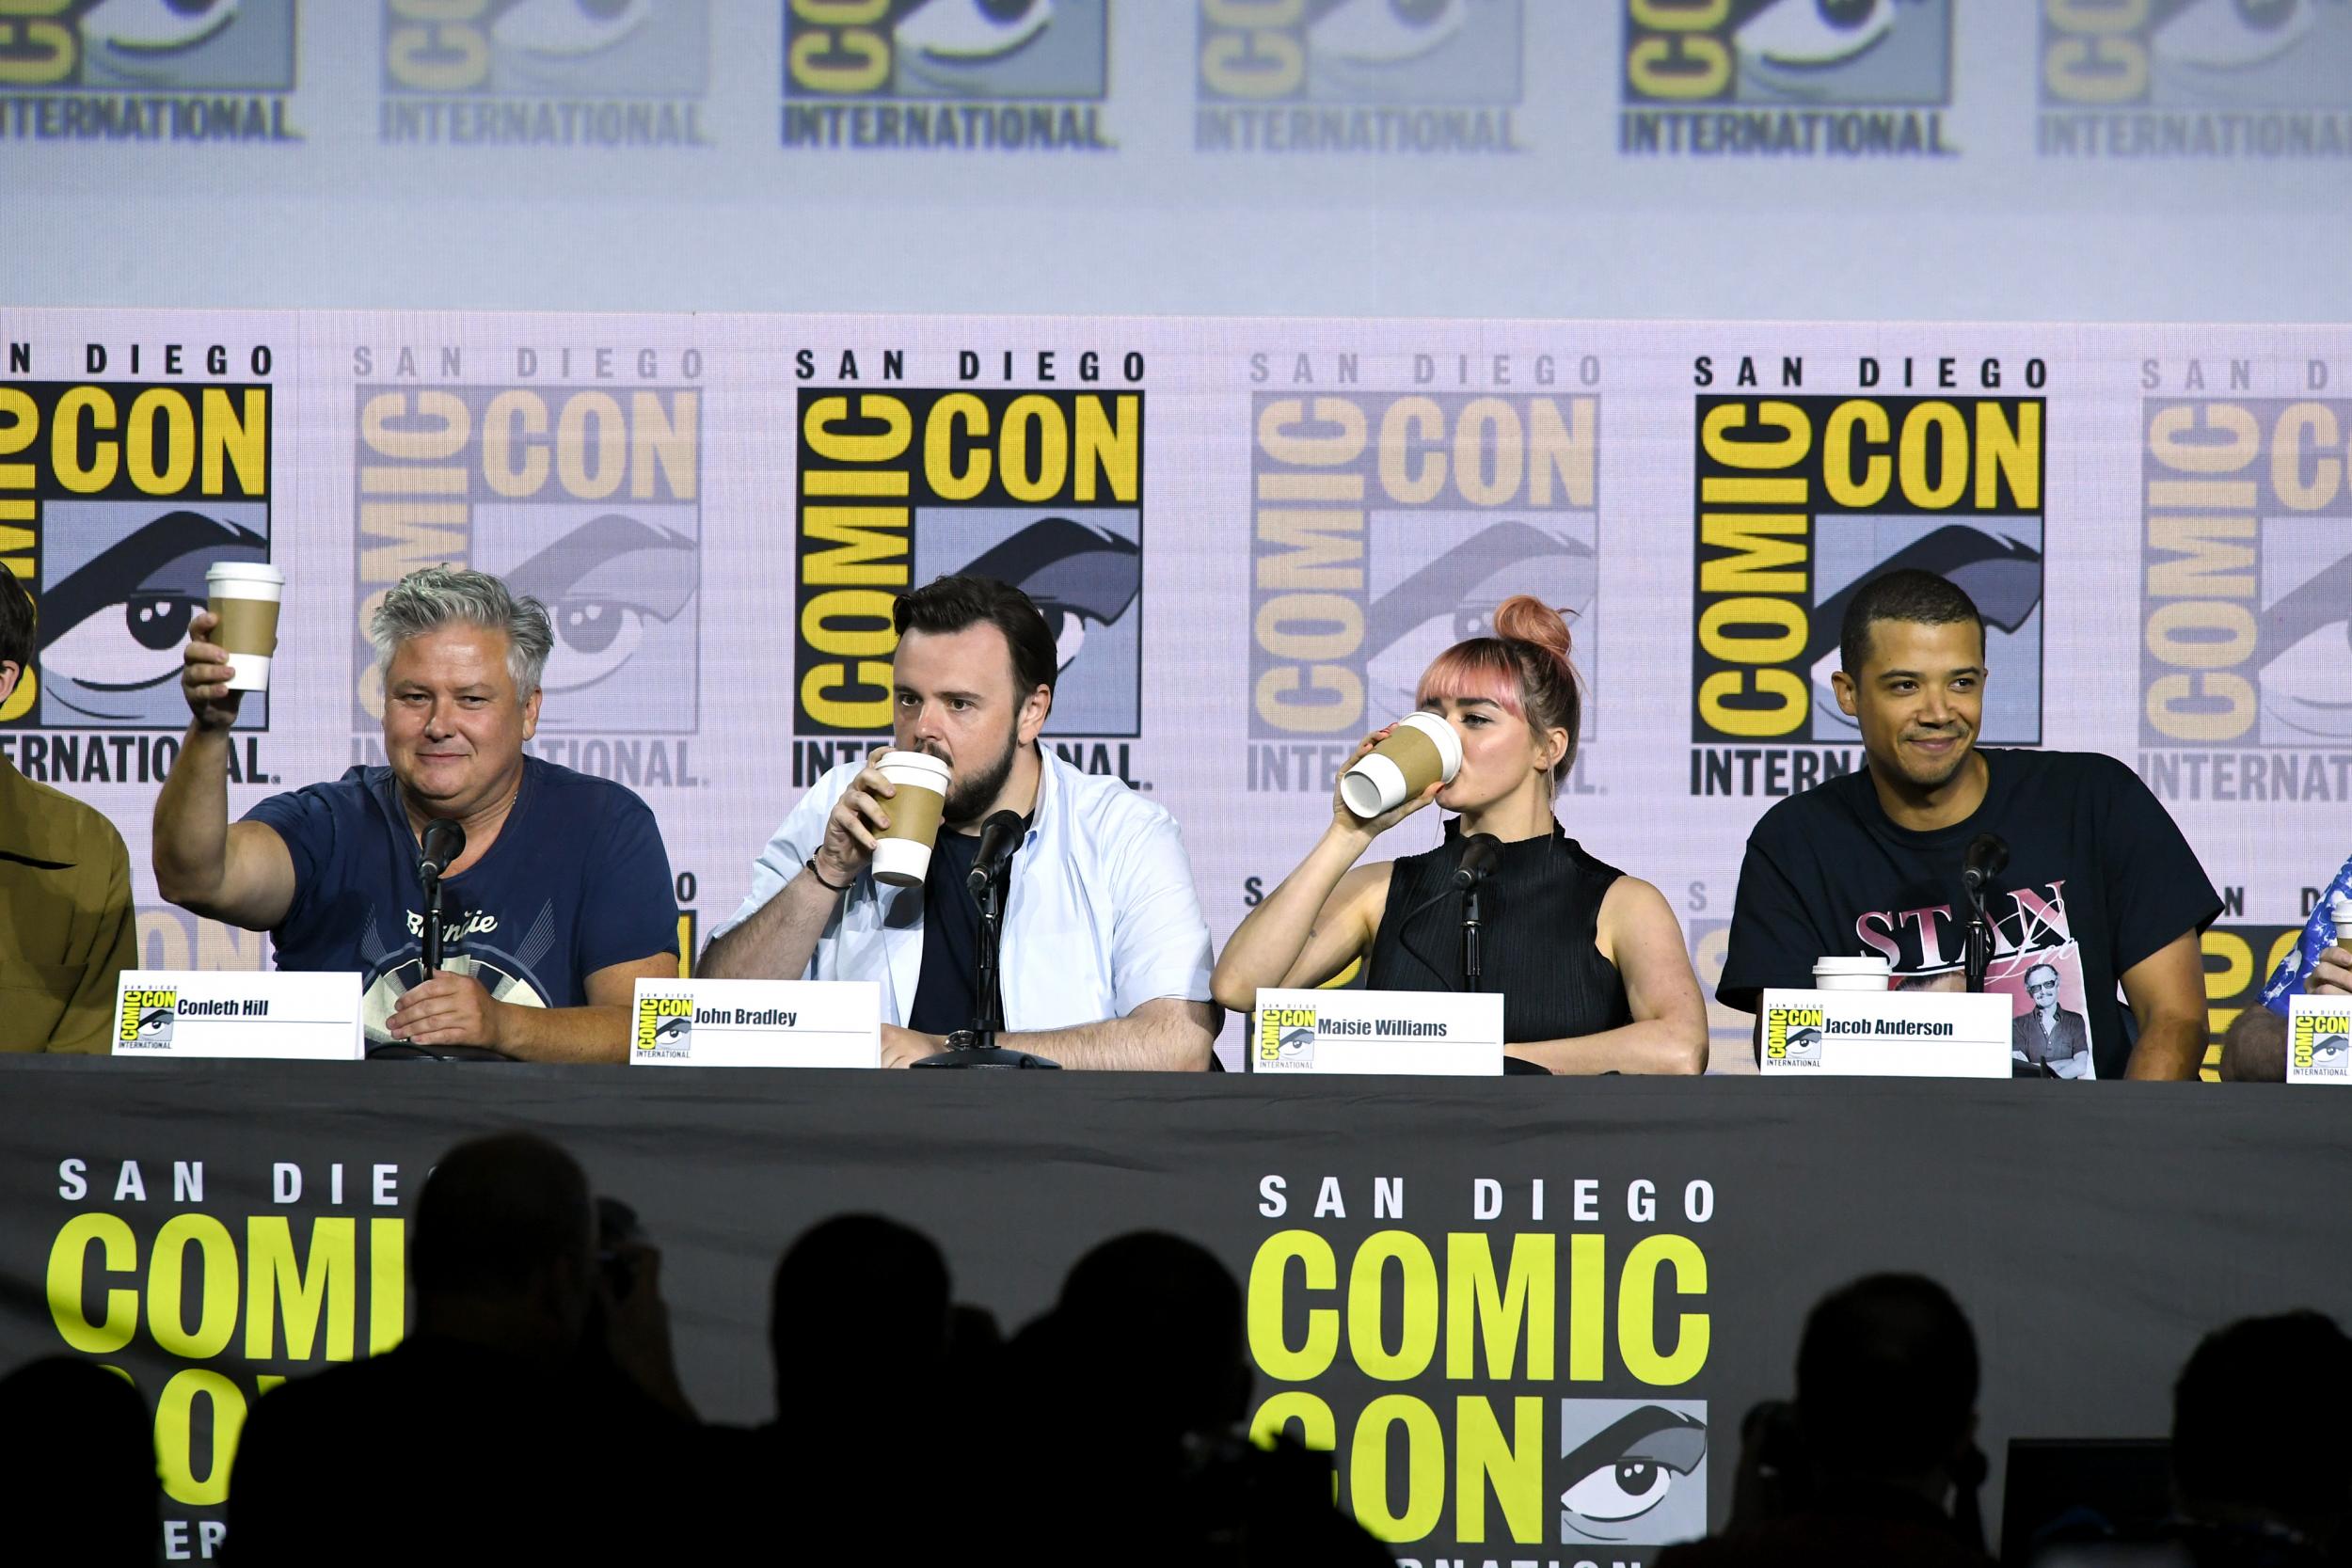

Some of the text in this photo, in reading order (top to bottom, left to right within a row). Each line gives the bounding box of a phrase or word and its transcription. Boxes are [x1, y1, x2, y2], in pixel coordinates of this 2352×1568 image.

[87, 343, 272, 375] DIEGO
[354, 346, 703, 379] SAN DIEGO
[795, 350, 1145, 382] SAN DIEGO
[1250, 352, 1601, 386] SAN DIEGO
[1693, 356, 2047, 388] SAN DIEGO
[2141, 358, 2251, 390] SAN
[51, 386, 266, 496] CON
[481, 388, 697, 500] CON
[923, 392, 1139, 502] CON
[1377, 395, 1596, 506] CON
[1822, 399, 2041, 510] CON
[1254, 395, 1370, 735] COMIC
[1697, 400, 1813, 737] COMIC
[2145, 402, 2261, 742] COMIC
[120, 990, 141, 1040] COMIC
[141, 990, 177, 1007] CON
[177, 998, 269, 1016] Conleth Hill
[659, 999, 693, 1017] CON
[638, 999, 659, 1050] COMIC
[694, 1007, 798, 1027] John Bradley
[1280, 1009, 1315, 1027] CON
[1317, 1018, 1448, 1037] Maisie Williams
[1768, 1009, 1788, 1058] COMIC
[1788, 1009, 1822, 1026] CON
[1824, 1018, 1954, 1037] Jacob Anderson
[2314, 1016, 2349, 1034] CON
[119, 1041, 172, 1050] INTERNATIONAL
[1261, 1009, 1280, 1060] COMIC
[2295, 1016, 2314, 1068] COMIC
[636, 1051, 691, 1059] INTERNATIONAL
[1259, 1061, 1313, 1069] INTERNATIONAL
[1767, 1059, 1821, 1068] INTERNATIONAL
[2293, 1069, 2348, 1077] INTERNATIONAL
[58, 1158, 204, 1202] SAN
[1258, 1175, 1715, 1223] SAN DIEGO
[46, 1212, 405, 1362] COMI
[1247, 1229, 1710, 1386] COMIC
